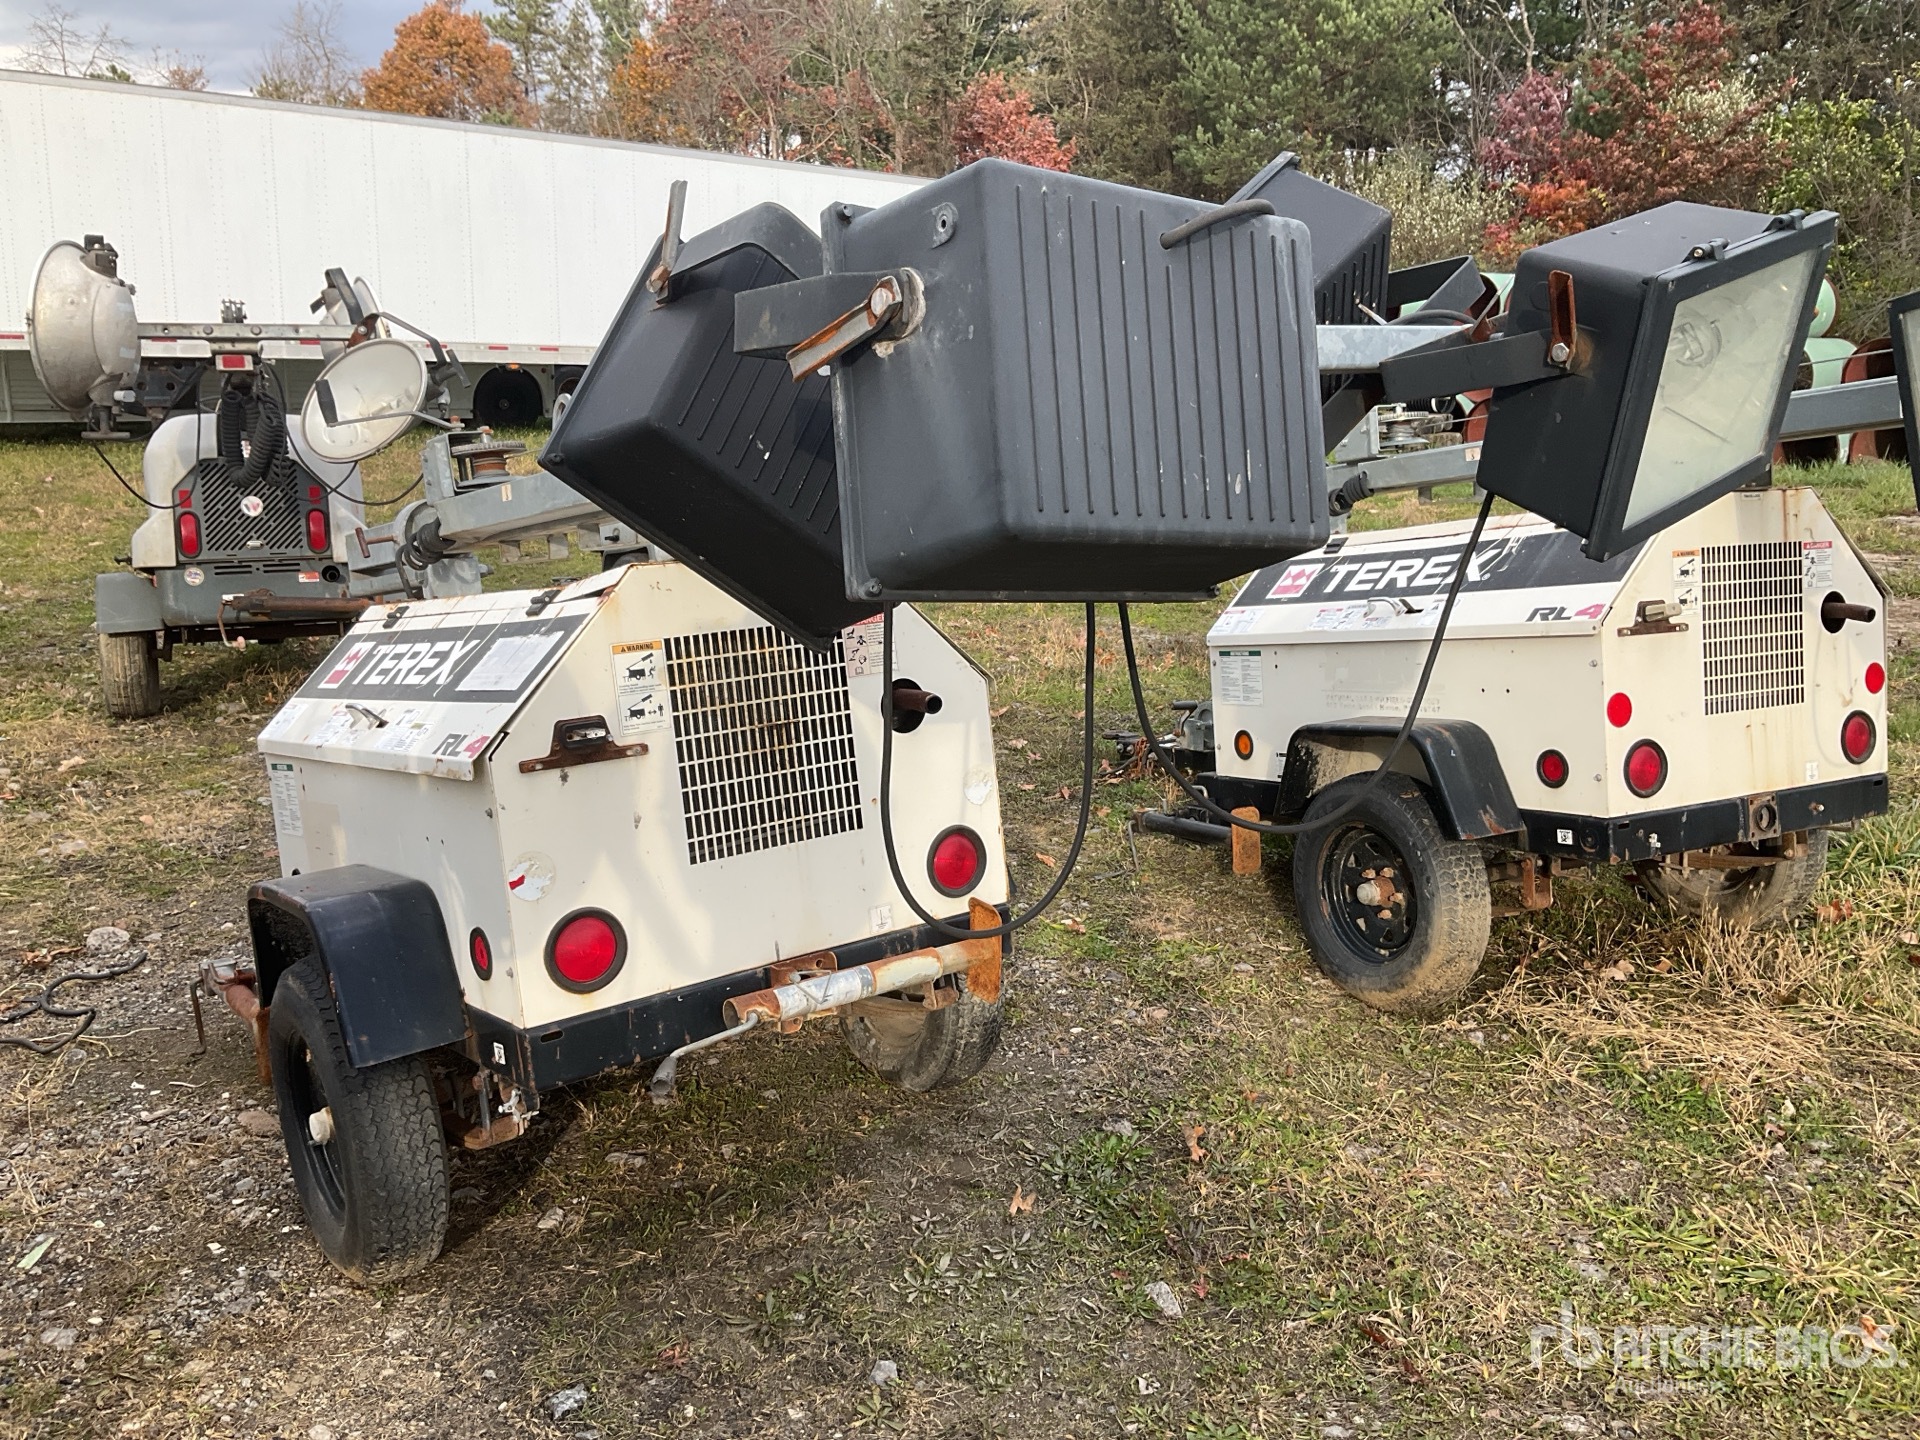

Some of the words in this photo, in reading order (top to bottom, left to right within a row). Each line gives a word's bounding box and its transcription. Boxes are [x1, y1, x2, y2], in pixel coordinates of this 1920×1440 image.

[1323, 549, 1501, 593] TEREX
[1525, 604, 1606, 622] RL4
[627, 643, 654, 652] WARNING
[352, 639, 480, 685] TEREX
[432, 733, 491, 759] RL4
